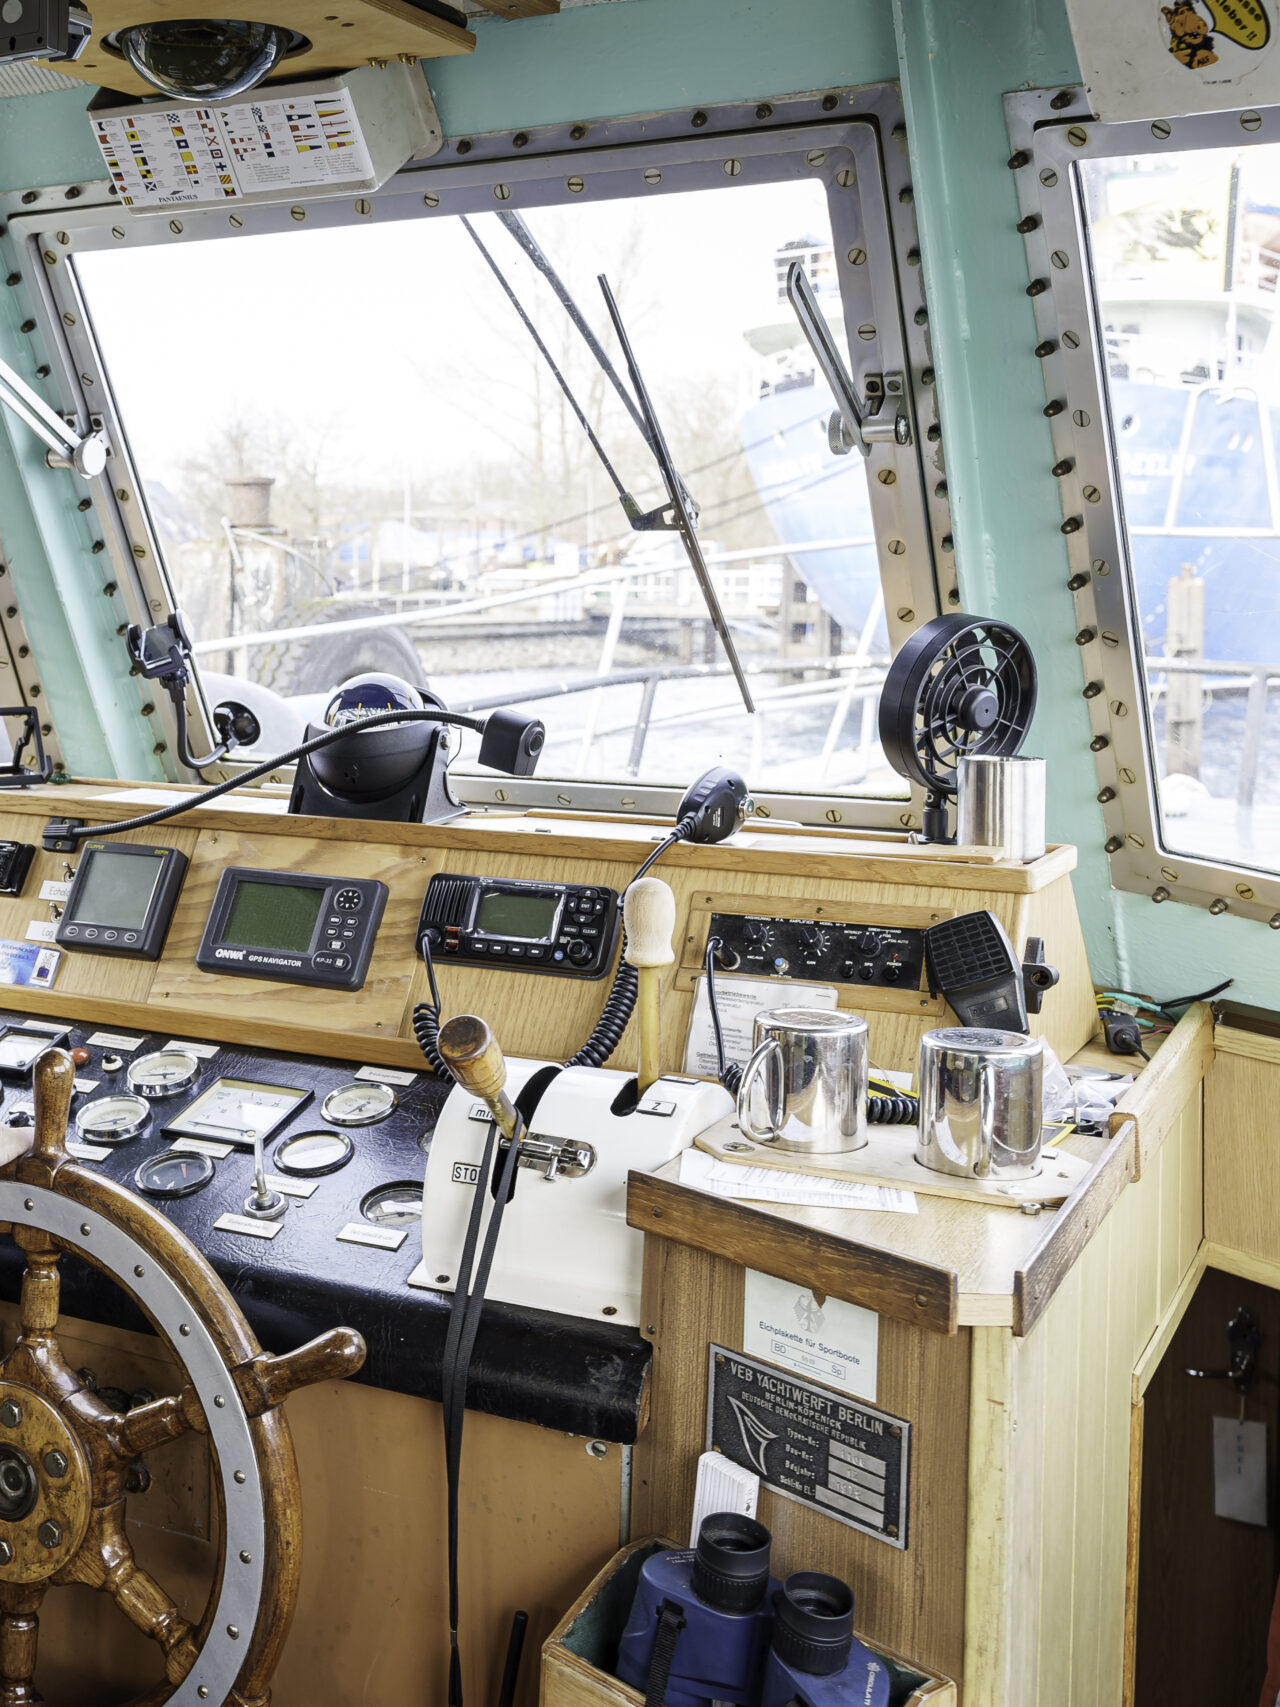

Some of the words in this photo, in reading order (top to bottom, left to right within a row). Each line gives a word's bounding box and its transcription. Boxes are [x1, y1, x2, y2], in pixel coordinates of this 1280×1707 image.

[158, 194, 199, 203] PANTAENIUS
[215, 948, 244, 961] ONWA
[248, 955, 263, 963] GPS
[262, 956, 302, 968] NAVIGATOR
[651, 1102, 662, 1111] Z
[454, 1166, 480, 1182] STO
[759, 1320, 804, 1344] Eichplakette
[805, 1338, 816, 1349] für
[818, 1342, 861, 1365] Sportboote
[774, 1342, 787, 1355] BD
[831, 1364, 842, 1376] Sp
[730, 1361, 754, 1383] VEB
[756, 1372, 833, 1416] YACHTWERFT
[838, 1406, 884, 1437] BERLIN
[764, 1391, 843, 1431] BERLIN-KÖPENICK
[741, 1391, 774, 1412] DEUTSCHE
[775, 1405, 829, 1436] DEMOKRATISCHE
[831, 1429, 867, 1451] REPUBLIK
